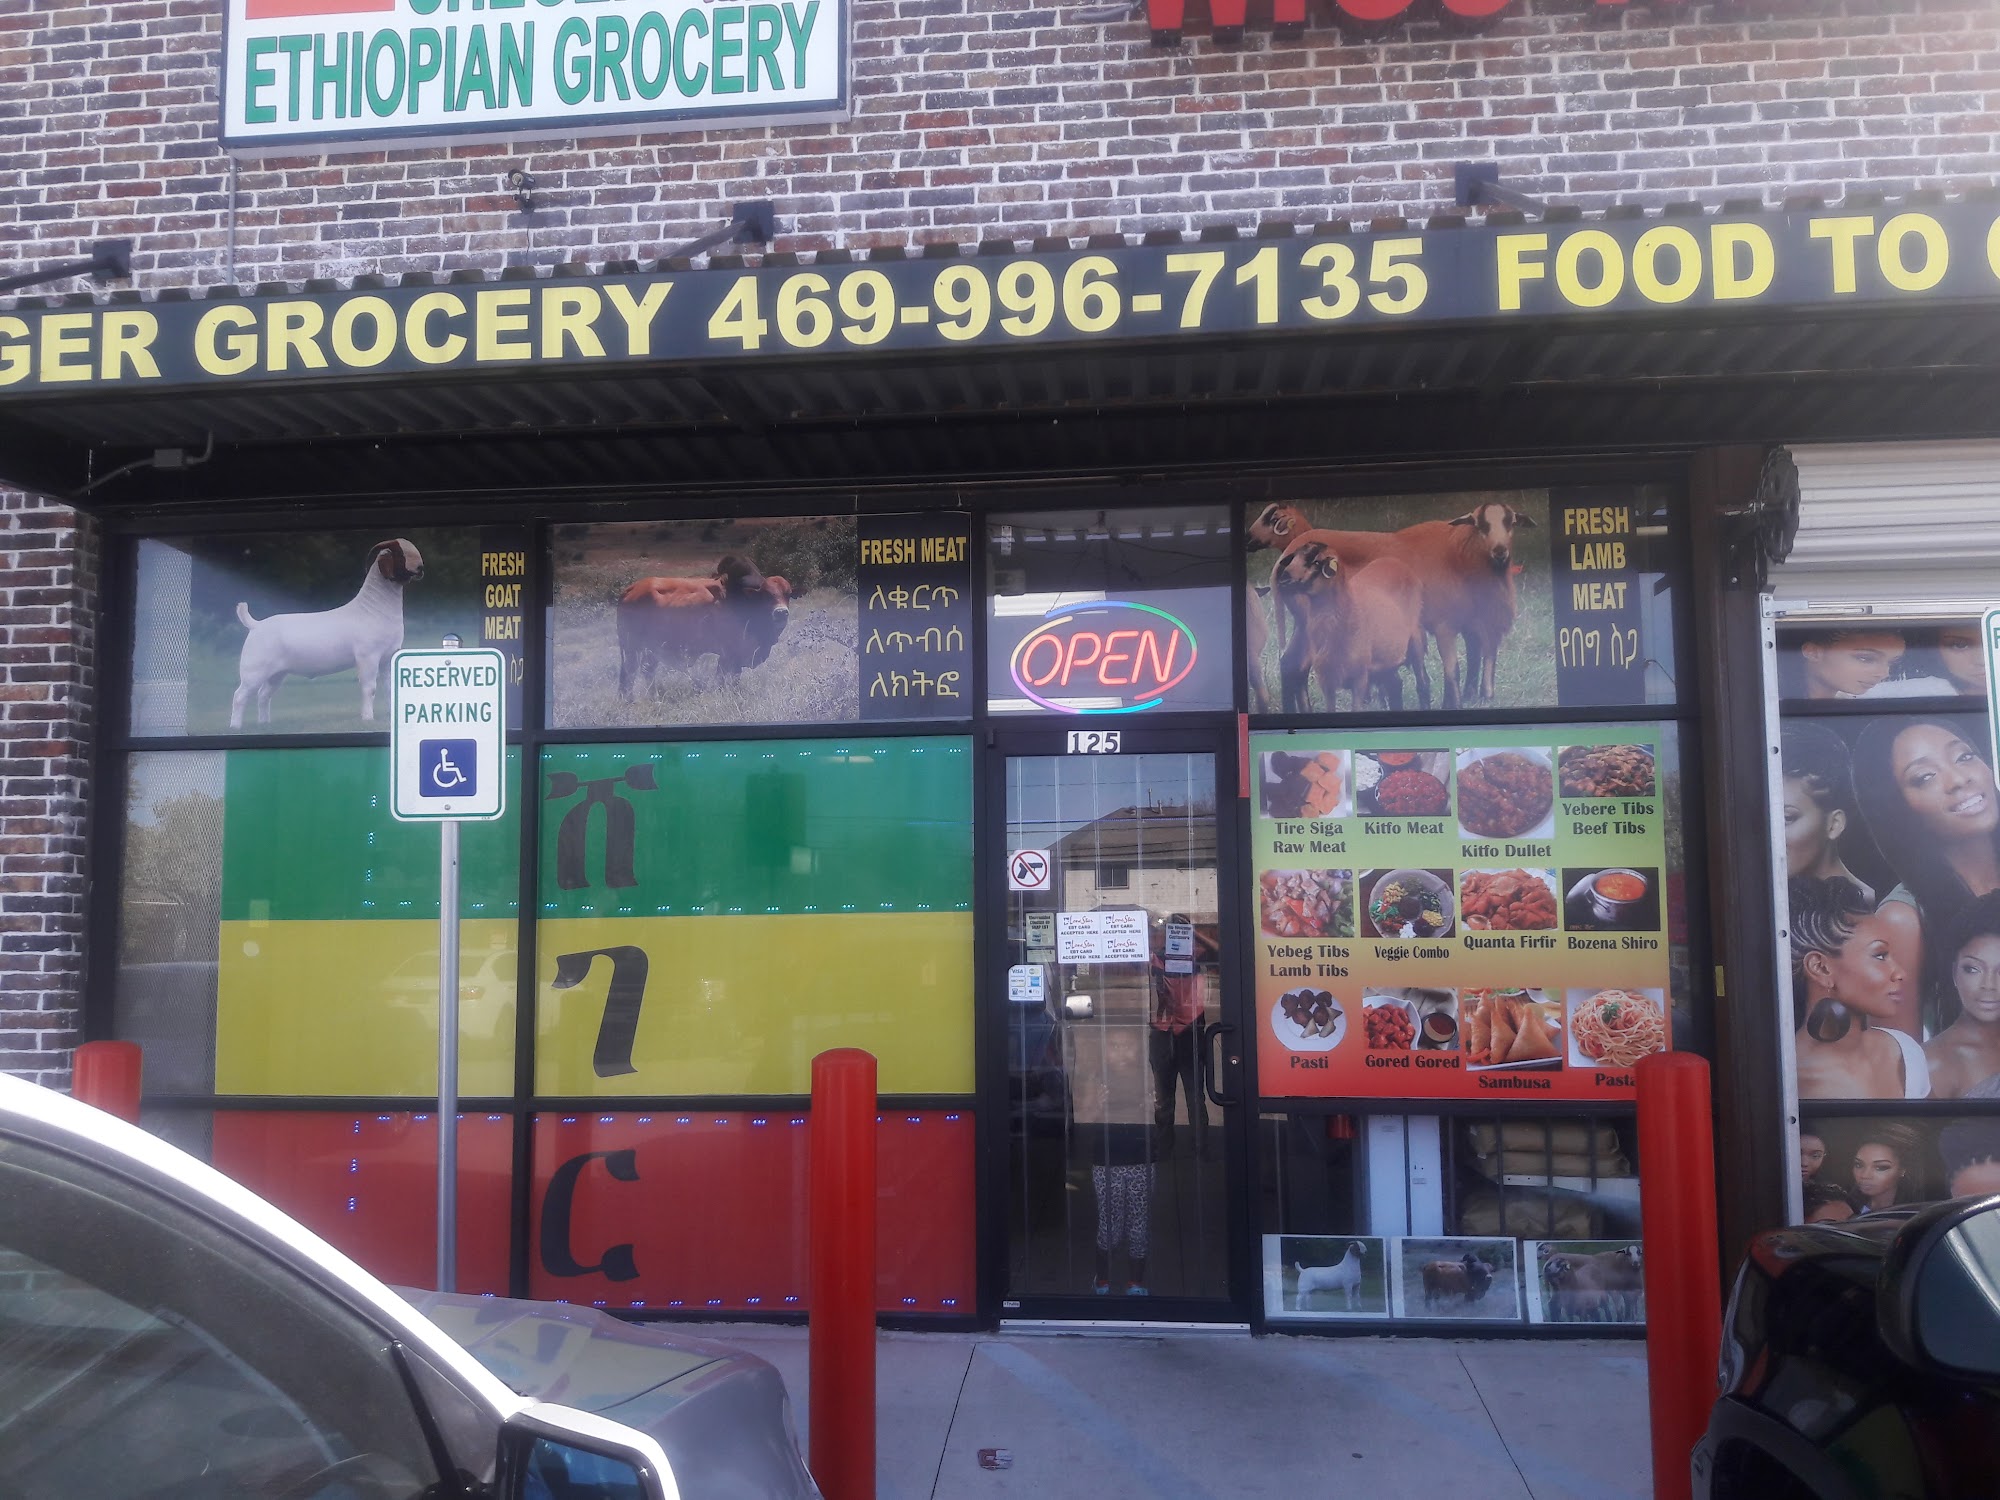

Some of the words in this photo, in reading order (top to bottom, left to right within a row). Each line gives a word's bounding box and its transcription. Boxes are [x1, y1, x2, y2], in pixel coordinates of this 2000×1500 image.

[245, 21, 534, 124] ETHIOPIAN
[553, 1, 820, 105] GROCERY
[194, 281, 674, 376] GROCERY
[708, 237, 1428, 350] 469-996-7135
[1495, 222, 1776, 311] FOOD
[1810, 213, 1949, 293] TO
[1564, 506, 1629, 535] FRESH
[861, 538, 916, 565] FRESH
[921, 536, 967, 563] MEAT
[1570, 542, 1626, 571] LAMB
[482, 552, 525, 576] FRESH
[485, 583, 521, 608] GOAT
[1572, 582, 1627, 611] MEAT
[485, 615, 521, 640] MEAT
[1021, 628, 1179, 687] OPEN
[400, 666, 497, 688] RESERVED
[404, 701, 492, 723] PARKING
[1072, 732, 1119, 753] 125
[1562, 802, 1616, 816] Yebere
[1622, 801, 1654, 815] Tibs
[1275, 821, 1305, 835] Tire
[1310, 821, 1343, 837] Siga
[1364, 821, 1401, 834] Kitfo
[1407, 821, 1444, 834] Meat
[1573, 821, 1608, 835] Beef
[1612, 821, 1646, 834] Tibs
[1273, 840, 1304, 853] Raw
[1309, 840, 1346, 853] Meat
[1462, 844, 1499, 857] Kitfo
[1505, 844, 1552, 857] Dullet
[1463, 935, 1515, 950] Quanta
[1520, 935, 1557, 949] Firfir
[1567, 936, 1617, 950] Bozena
[1621, 936, 1658, 949] Shiro
[1267, 944, 1313, 960] Yebeg
[1317, 944, 1350, 958] Tibs
[1374, 945, 1410, 961] Veggie
[1413, 945, 1449, 959] Combo
[1269, 964, 1312, 977] Lamb
[1316, 964, 1349, 977] Tibs
[1290, 1055, 1328, 1069] Pasti
[1365, 1054, 1410, 1068] Gored
[1415, 1054, 1460, 1068] Gored
[1478, 1074, 1551, 1089] Sambusa
